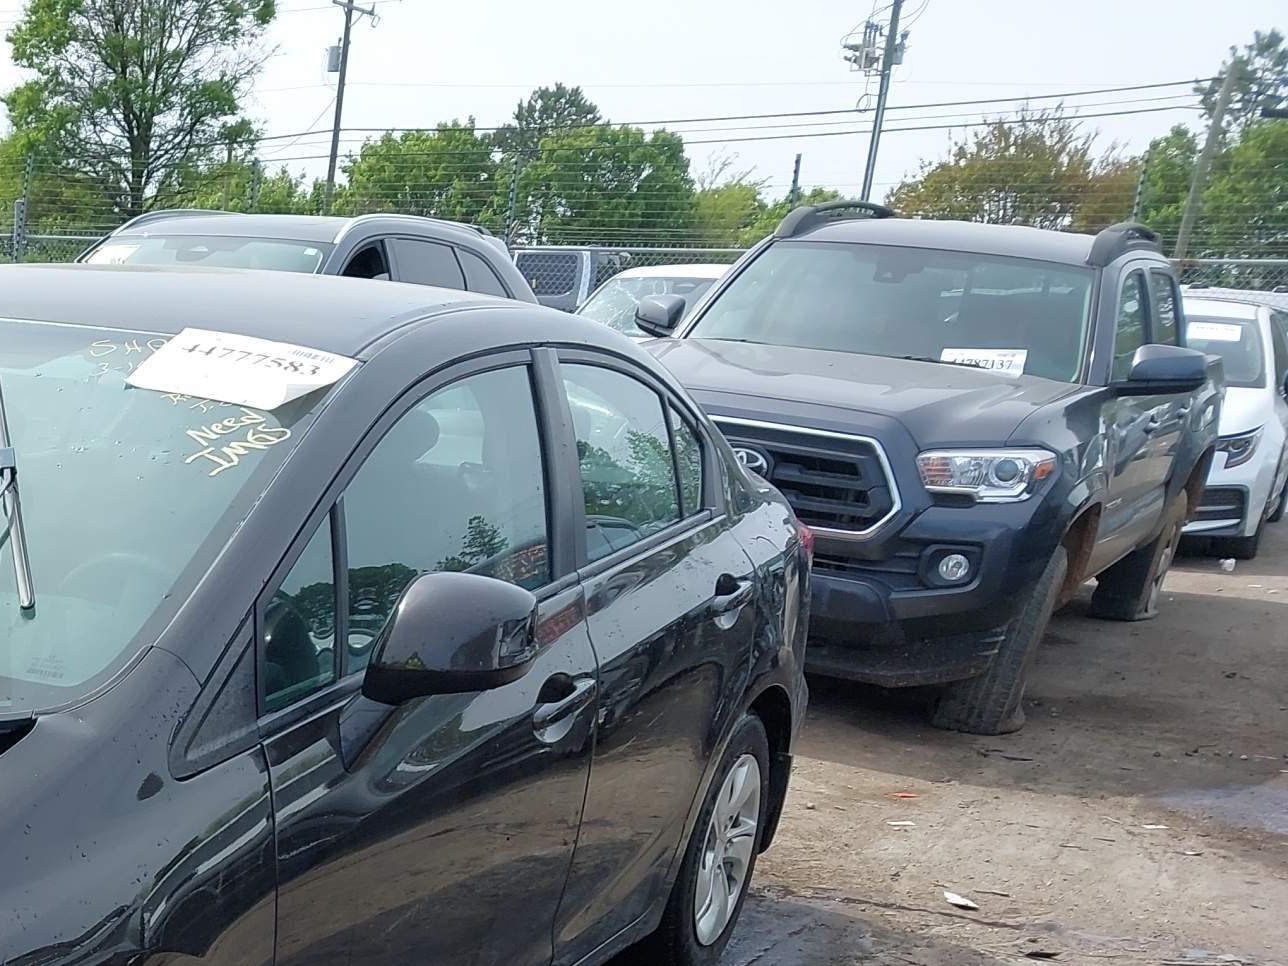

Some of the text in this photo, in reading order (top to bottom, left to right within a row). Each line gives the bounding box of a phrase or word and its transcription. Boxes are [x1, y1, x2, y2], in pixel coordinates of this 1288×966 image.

[182, 342, 321, 376] 44777583
[185, 407, 267, 447] Need
[184, 423, 292, 477] IMGS
